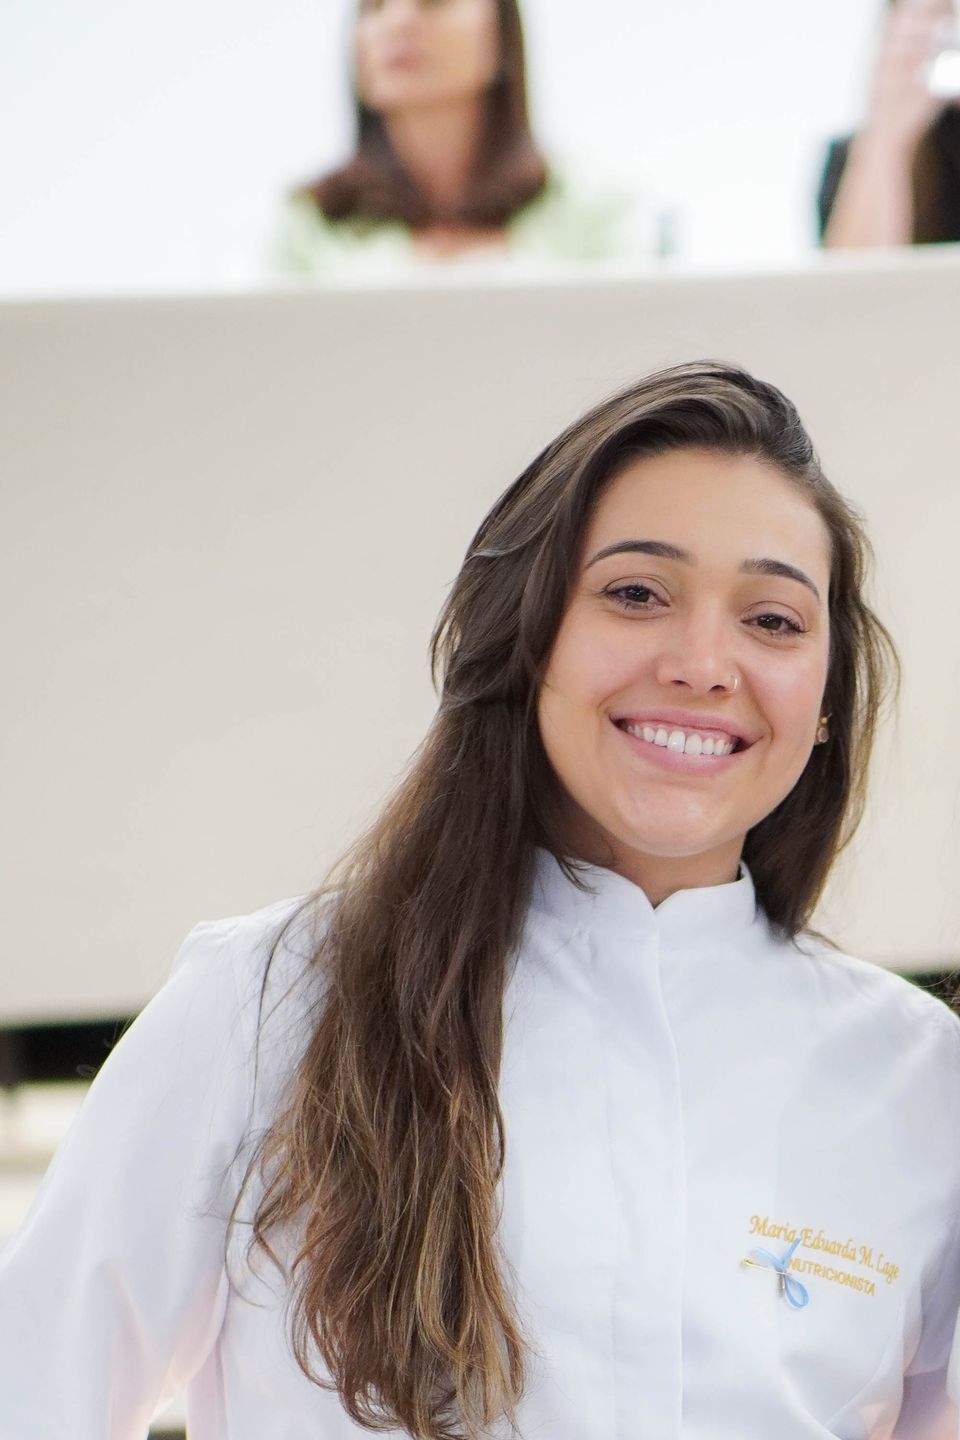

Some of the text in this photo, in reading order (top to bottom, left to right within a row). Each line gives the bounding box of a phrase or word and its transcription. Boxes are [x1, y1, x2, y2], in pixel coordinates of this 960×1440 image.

[749, 1215, 797, 1243] Maria
[800, 1228, 857, 1260] Eduarda
[858, 1246, 874, 1268] M.
[789, 1258, 876, 1296] NUTRICIONISTA
